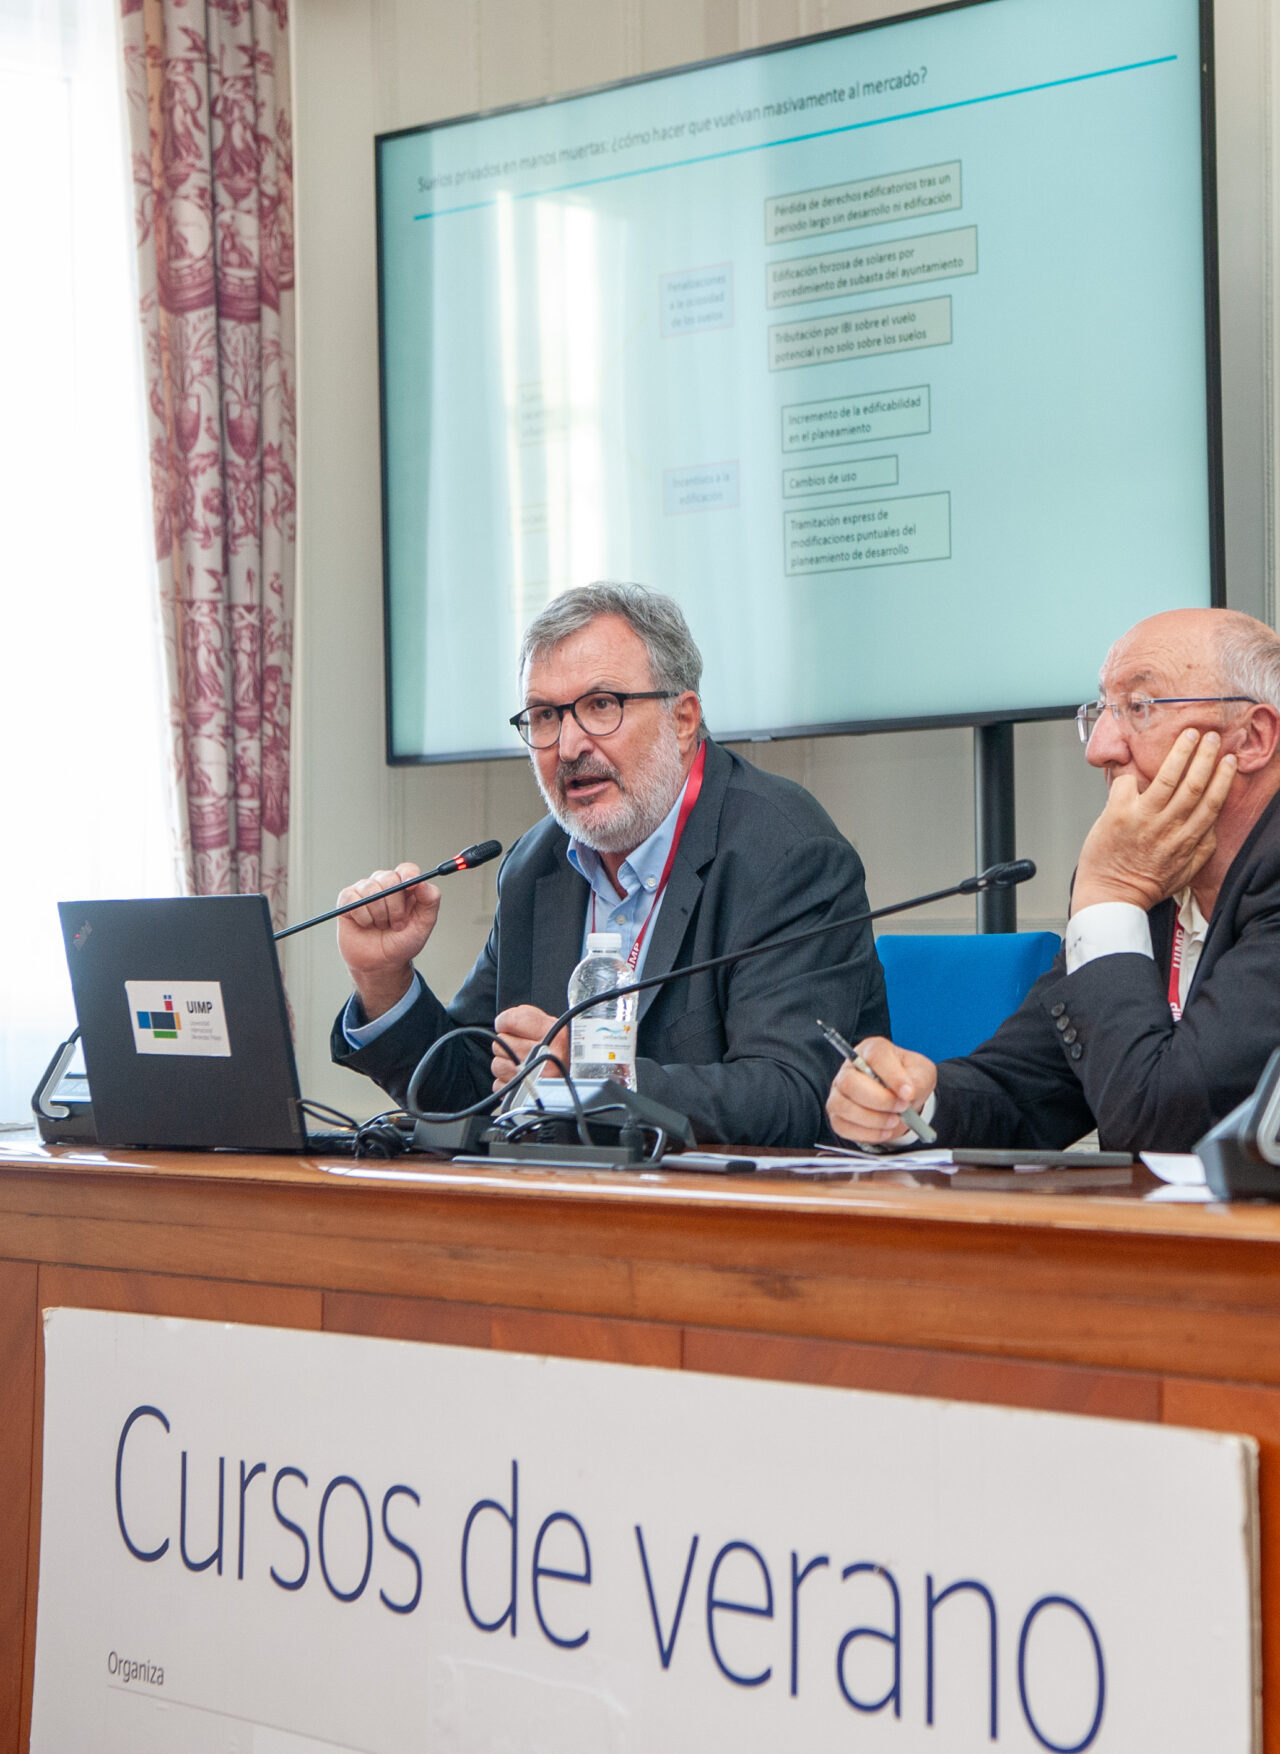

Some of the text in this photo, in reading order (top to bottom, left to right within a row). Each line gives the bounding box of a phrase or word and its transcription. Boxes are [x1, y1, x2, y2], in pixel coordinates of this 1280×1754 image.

[455, 162, 500, 188] privados
[503, 160, 517, 174] en
[520, 153, 557, 170] manos
[611, 131, 650, 154] ¿cómo
[652, 122, 685, 143] hacer
[688, 118, 711, 142] que
[714, 106, 762, 129] vuelvan
[763, 87, 846, 119] masivamente
[848, 80, 860, 100] al
[863, 66, 928, 97] mercado?
[809, 198, 820, 211] de
[822, 190, 861, 208] derechos
[863, 179, 918, 200] edificatorios
[920, 176, 937, 189] tras
[939, 174, 951, 185] un
[809, 213, 830, 229] largo
[832, 212, 845, 225] sin
[847, 204, 890, 222] desarrollo
[893, 201, 902, 213] ni
[904, 191, 952, 210] edificación
[773, 248, 915, 283] Edificación forzosa de solares por
[773, 257, 964, 301] procedimiento de subasta del ayuntamiento
[775, 325, 822, 344] Tributación
[823, 324, 839, 339] por
[855, 318, 880, 333] sobre
[881, 315, 890, 327] el
[892, 312, 917, 325] vuelo
[775, 345, 815, 365] potencial
[823, 343, 835, 354] no
[837, 339, 855, 352] solo
[857, 334, 881, 349] sobre
[884, 332, 896, 345] los
[898, 329, 927, 343] suelos
[789, 396, 921, 425] Incremento de la edificabilidad
[789, 423, 871, 444] en el planeamiento
[789, 471, 857, 489] Cambios de uso
[791, 508, 888, 531] Tramitación express de
[791, 524, 916, 549] modificaciones puntuales del
[791, 543, 909, 569] planeamiento de desarrollo
[627, 942, 640, 969] IMP
[186, 1000, 213, 1014] UIMP
[112, 1404, 1107, 1754] Cursos de verano
[107, 1650, 165, 1686] Organiza
